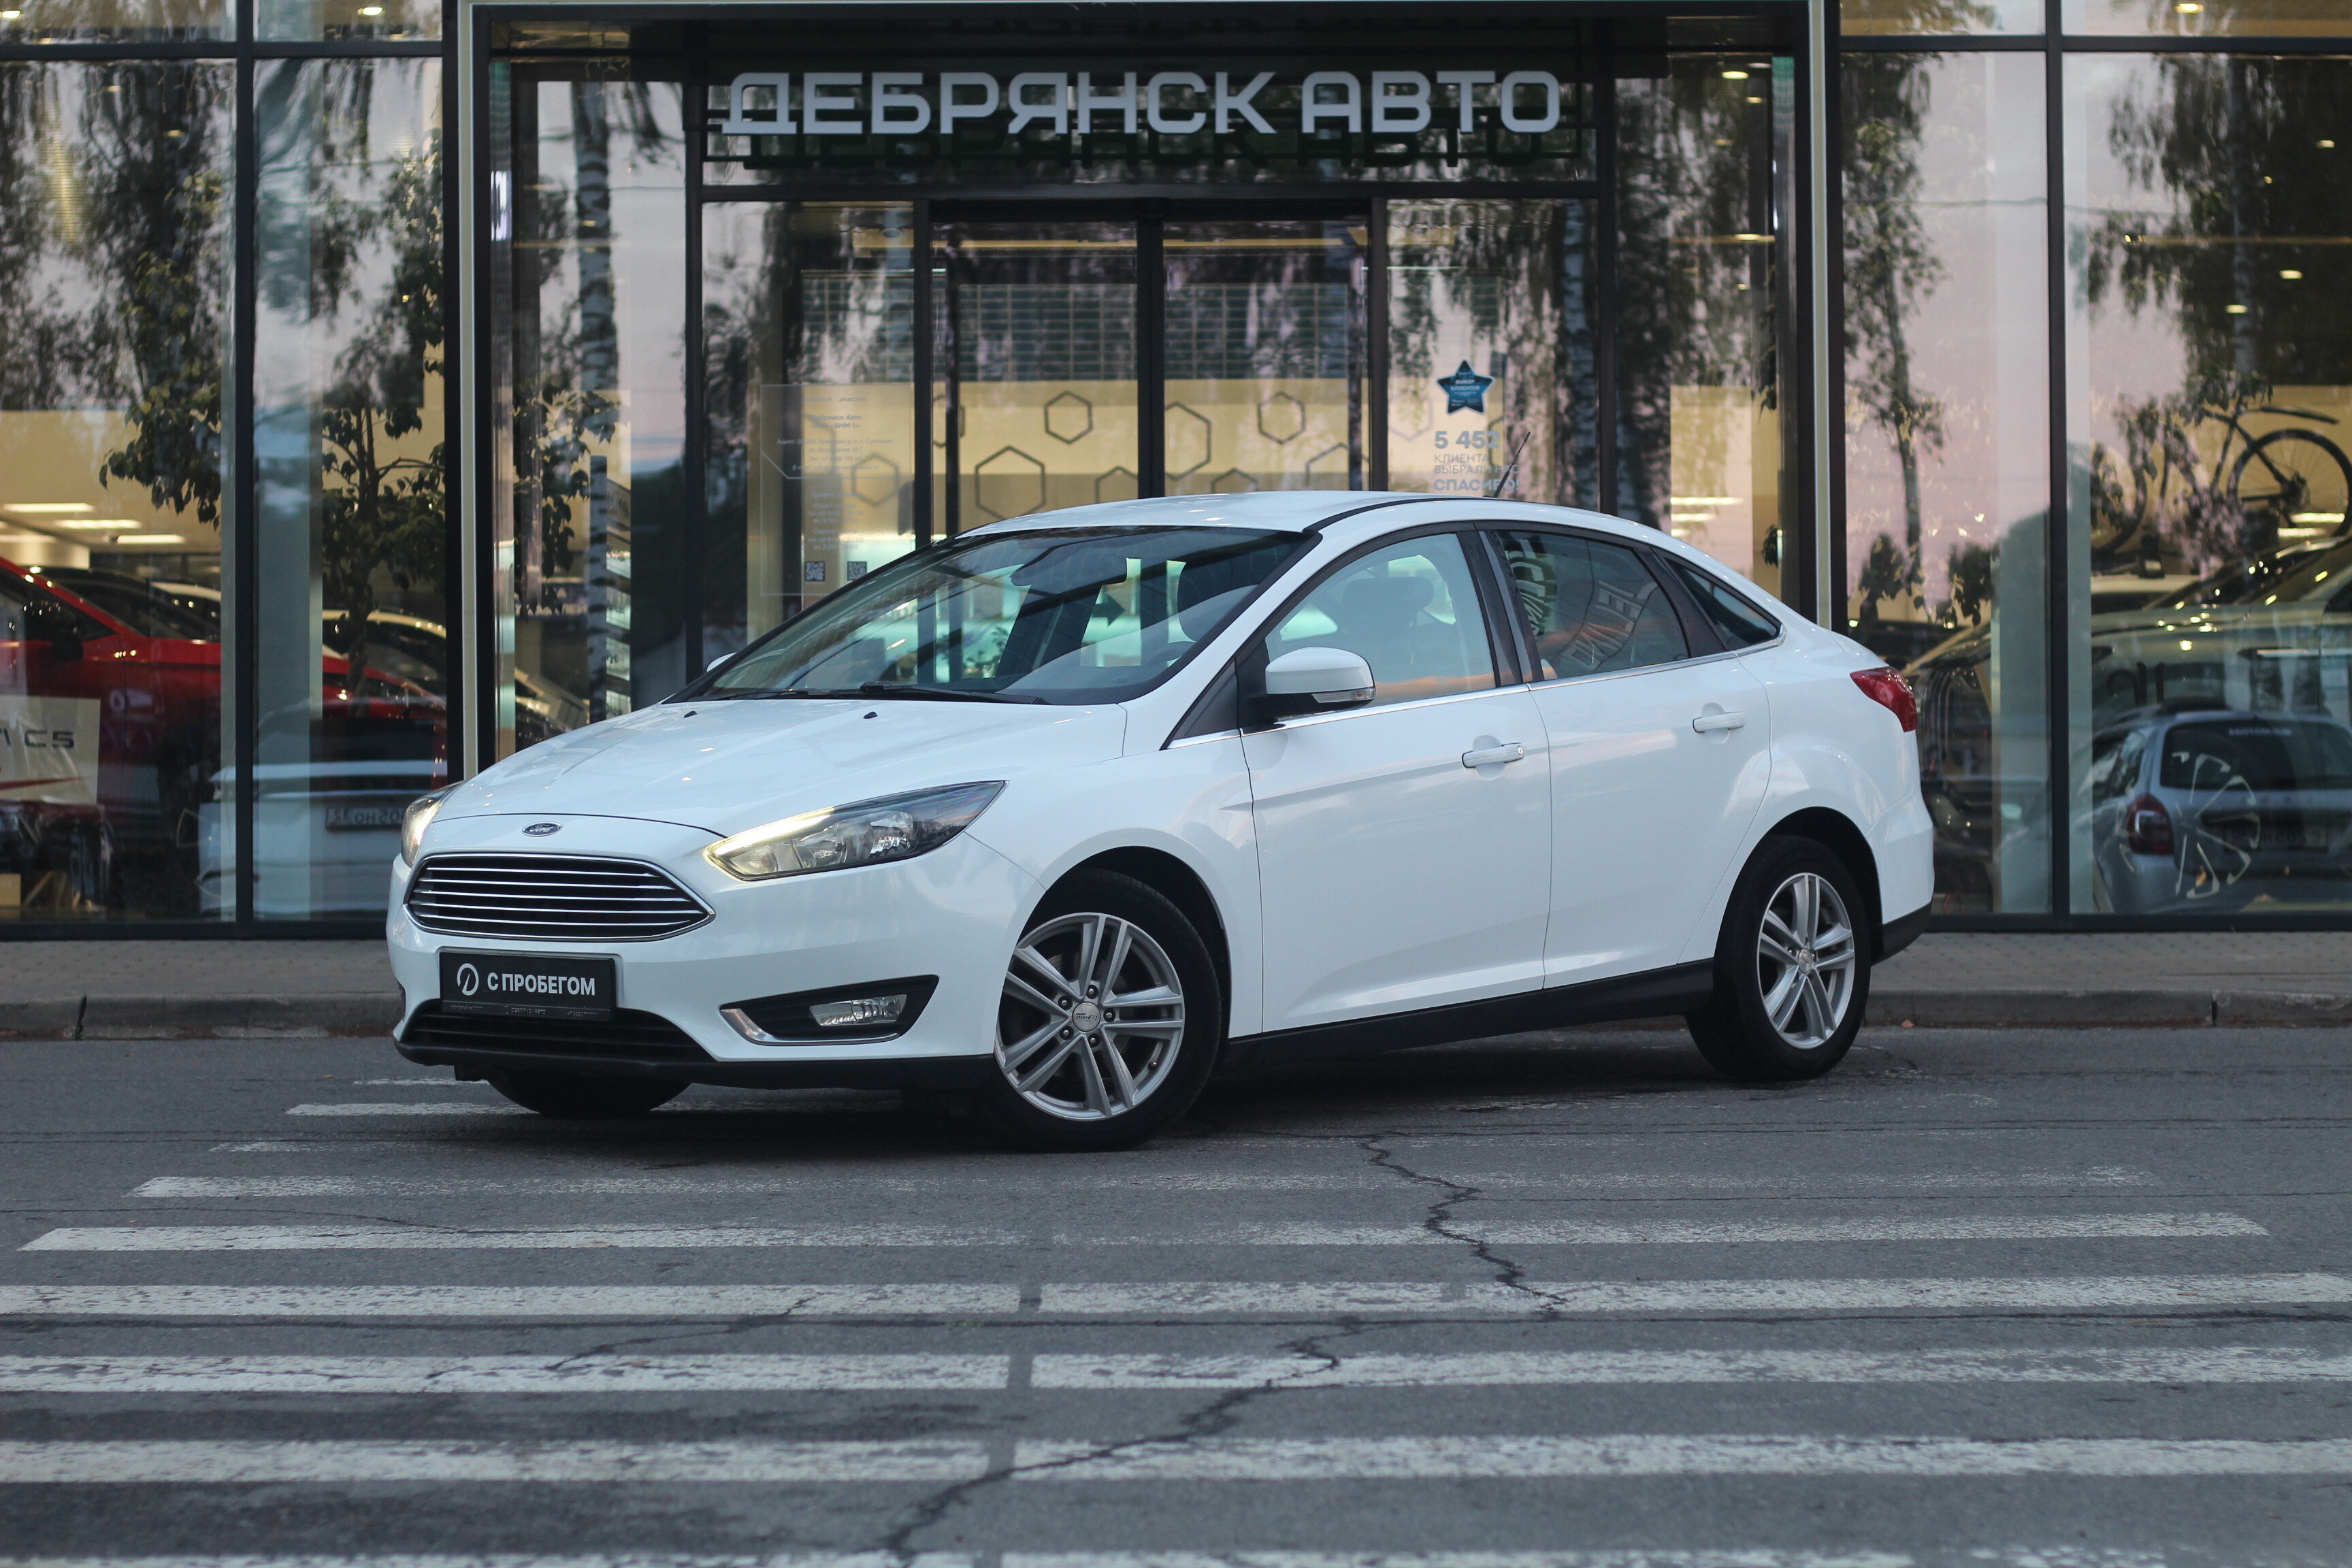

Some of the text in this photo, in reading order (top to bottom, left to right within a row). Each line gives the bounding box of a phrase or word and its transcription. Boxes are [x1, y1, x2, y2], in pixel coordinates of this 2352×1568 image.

[721, 71, 1560, 135] ДЕБРЯНСК АВТО
[1435, 430, 1501, 449] 5 452
[1434, 453, 1489, 463] КЛИЕНТА
[1434, 465, 1492, 474] ВЫБРАЛИ
[487, 972, 595, 996] С ПРОБЕГОМ
